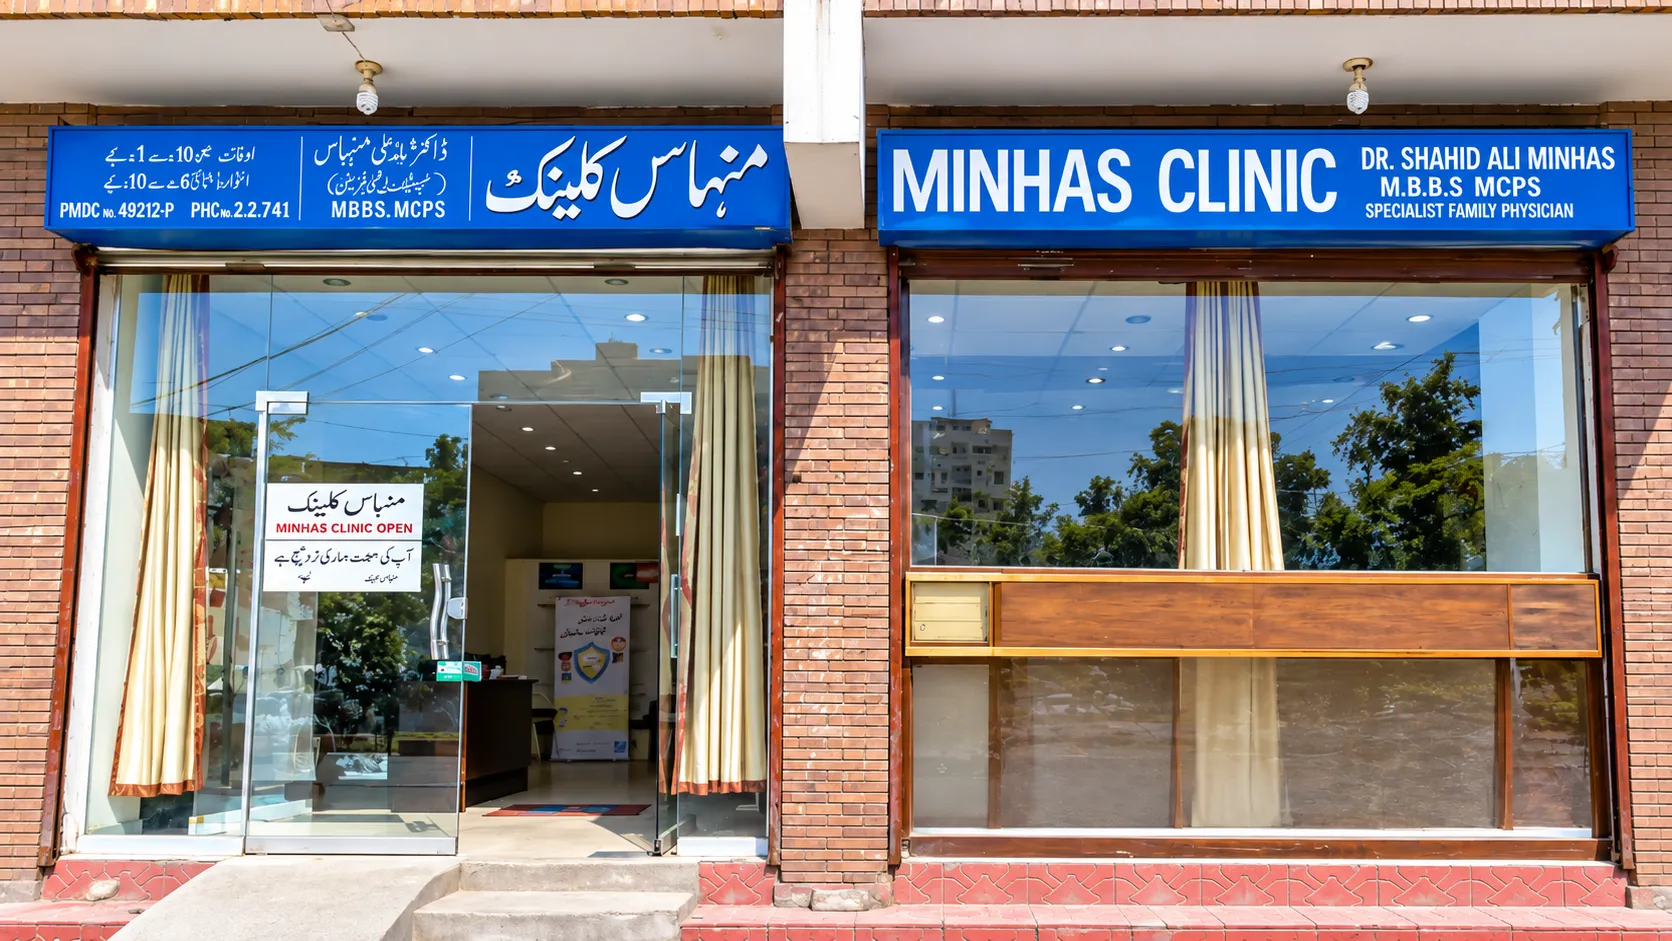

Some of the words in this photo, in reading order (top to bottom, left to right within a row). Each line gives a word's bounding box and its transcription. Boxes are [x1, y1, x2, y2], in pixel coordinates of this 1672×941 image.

[1361, 146, 1395, 170] DR.
[1401, 146, 1481, 171] SHAHID
[1487, 146, 1521, 170] ALI
[1527, 146, 1616, 171] MINHAS
[485, 135, 628, 220] کلینک
[610, 139, 769, 219] منہاس
[893, 148, 1133, 213] MINHAS
[1158, 147, 1338, 213] CLINIC
[1380, 176, 1463, 198] M.B.B.S
[1474, 176, 1541, 198] MCPS
[59, 202, 100, 218] PMDC
[118, 201, 175, 218] 49212-P
[1365, 202, 1445, 219] SPECIALIST
[1448, 202, 1497, 219] FAMILY
[1501, 202, 1574, 219] PHYSICIAN
[287, 489, 348, 518] کلینک
[276, 523, 328, 534] MINHAS
[331, 523, 373, 534] CLINIC
[376, 523, 413, 534] OPEN
